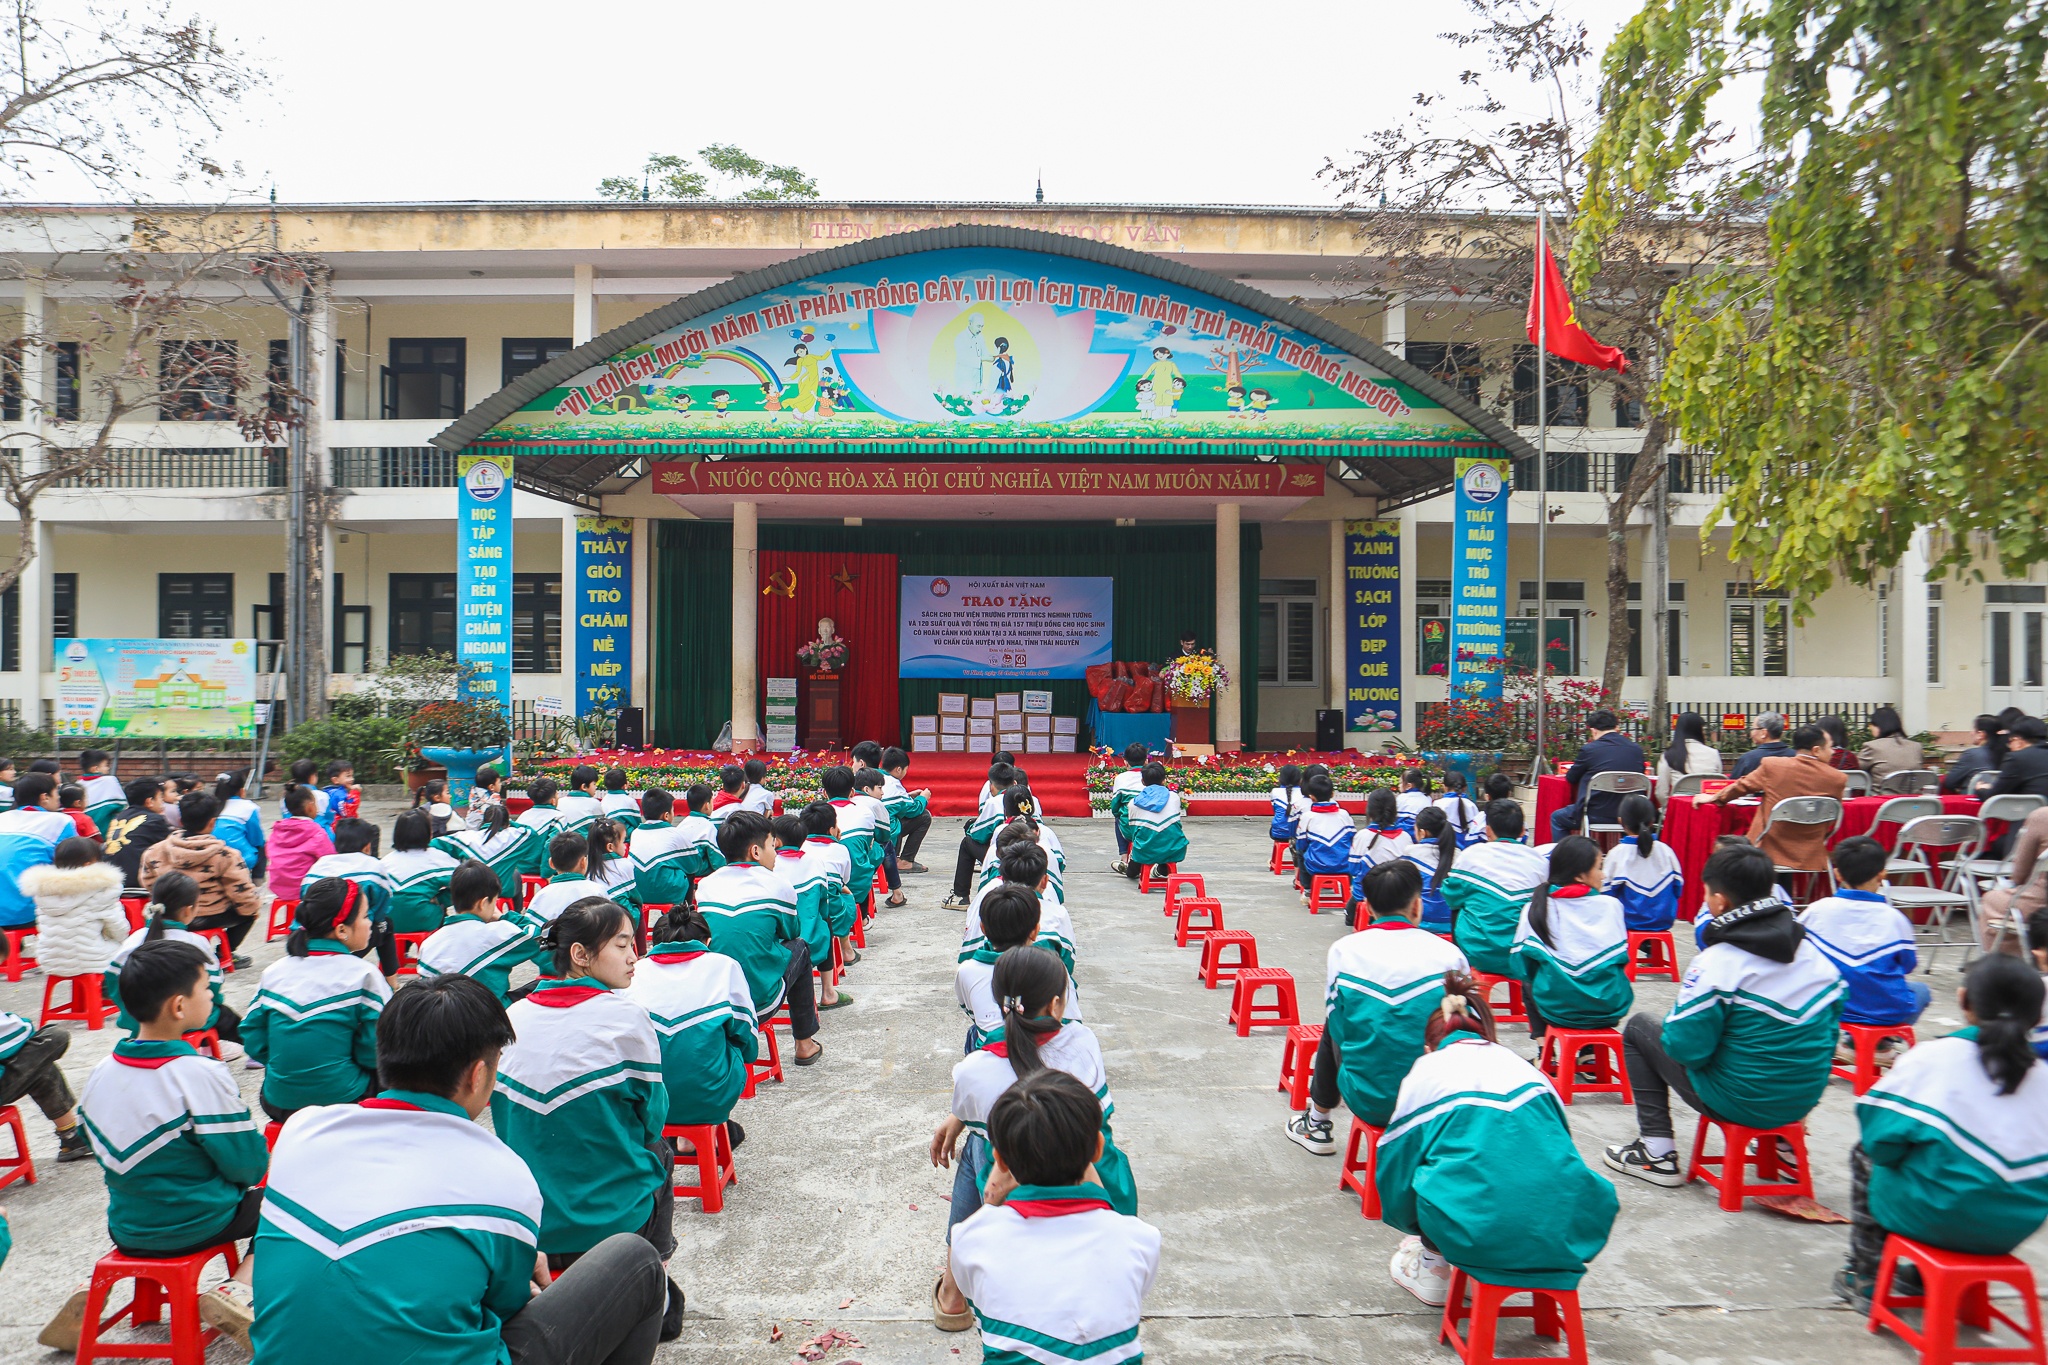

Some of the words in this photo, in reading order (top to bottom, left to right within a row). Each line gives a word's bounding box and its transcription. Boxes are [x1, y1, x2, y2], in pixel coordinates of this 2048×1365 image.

[810, 217, 873, 239] TIÊN
[1125, 221, 1181, 242] VĂN
[587, 372, 620, 405] LỢI
[617, 349, 655, 386] ÍCH
[654, 329, 709, 369] MƯỜI
[710, 309, 760, 345] NĂM
[760, 297, 796, 331] THÌ
[799, 284, 848, 321] PHẢI
[850, 276, 919, 310] TRỒNG
[923, 277, 971, 305] CÂY,
[975, 275, 997, 302] VÌ
[1001, 279, 1034, 308] LỢI
[1037, 277, 1072, 305] ÍCH
[1077, 284, 1136, 315] TRĂM
[1139, 294, 1189, 327] NĂM
[1192, 306, 1228, 338] THÌ
[1226, 320, 1278, 356] PHẢI
[1278, 336, 1342, 385] TRỒNG
[708, 466, 763, 488] NƯỚC
[768, 466, 823, 493] CỘNG
[827, 467, 869, 489] HÒA
[872, 467, 899, 489] XÃ
[903, 467, 938, 493] HỘI
[944, 465, 986, 488] CHỦ
[990, 468, 1053, 490] NGHĨA
[1056, 468, 1103, 494] VIỆT
[1107, 473, 1150, 490] NAM
[1155, 468, 1213, 490] MUÔN
[1217, 469, 1260, 490] NĂM
[471, 508, 496, 523] HỌC
[471, 525, 495, 542] TẬP
[468, 544, 502, 559] SÁNG
[581, 537, 627, 554] THẦY
[1353, 542, 1393, 555] XANH
[1465, 547, 1493, 562] MỰC
[474, 565, 497, 580] TẠO
[587, 561, 622, 579] GIỎI
[1348, 564, 1399, 579] TRƯỜNG
[1467, 564, 1490, 579] TRÒ
[471, 583, 496, 597] RÈN
[968, 581, 981, 589] HỘI
[982, 580, 999, 588] XUẤT
[1015, 581, 1028, 589] VIỆT
[1462, 584, 1497, 598] CHĂM
[587, 587, 622, 603] TRÒ
[961, 596, 1004, 607] TRAO
[1008, 593, 1053, 610] TẶNG
[1355, 590, 1391, 606] SẠCH
[464, 602, 502, 618] LUYỆN
[1457, 604, 1498, 617] NGOAN
[580, 612, 628, 627] CHĂM
[1076, 621, 1089, 629] HỌC
[1360, 612, 1387, 628] LỚP
[465, 621, 501, 635] CHĂM
[1456, 621, 1502, 636] TRƯỜNG
[464, 642, 506, 655] NGOAN
[592, 635, 615, 652] NỀ
[1361, 639, 1387, 655] ĐẸP
[590, 659, 622, 676] NẾP
[1359, 661, 1388, 677] QUÊ
[1349, 687, 1399, 701] HƯƠNG
